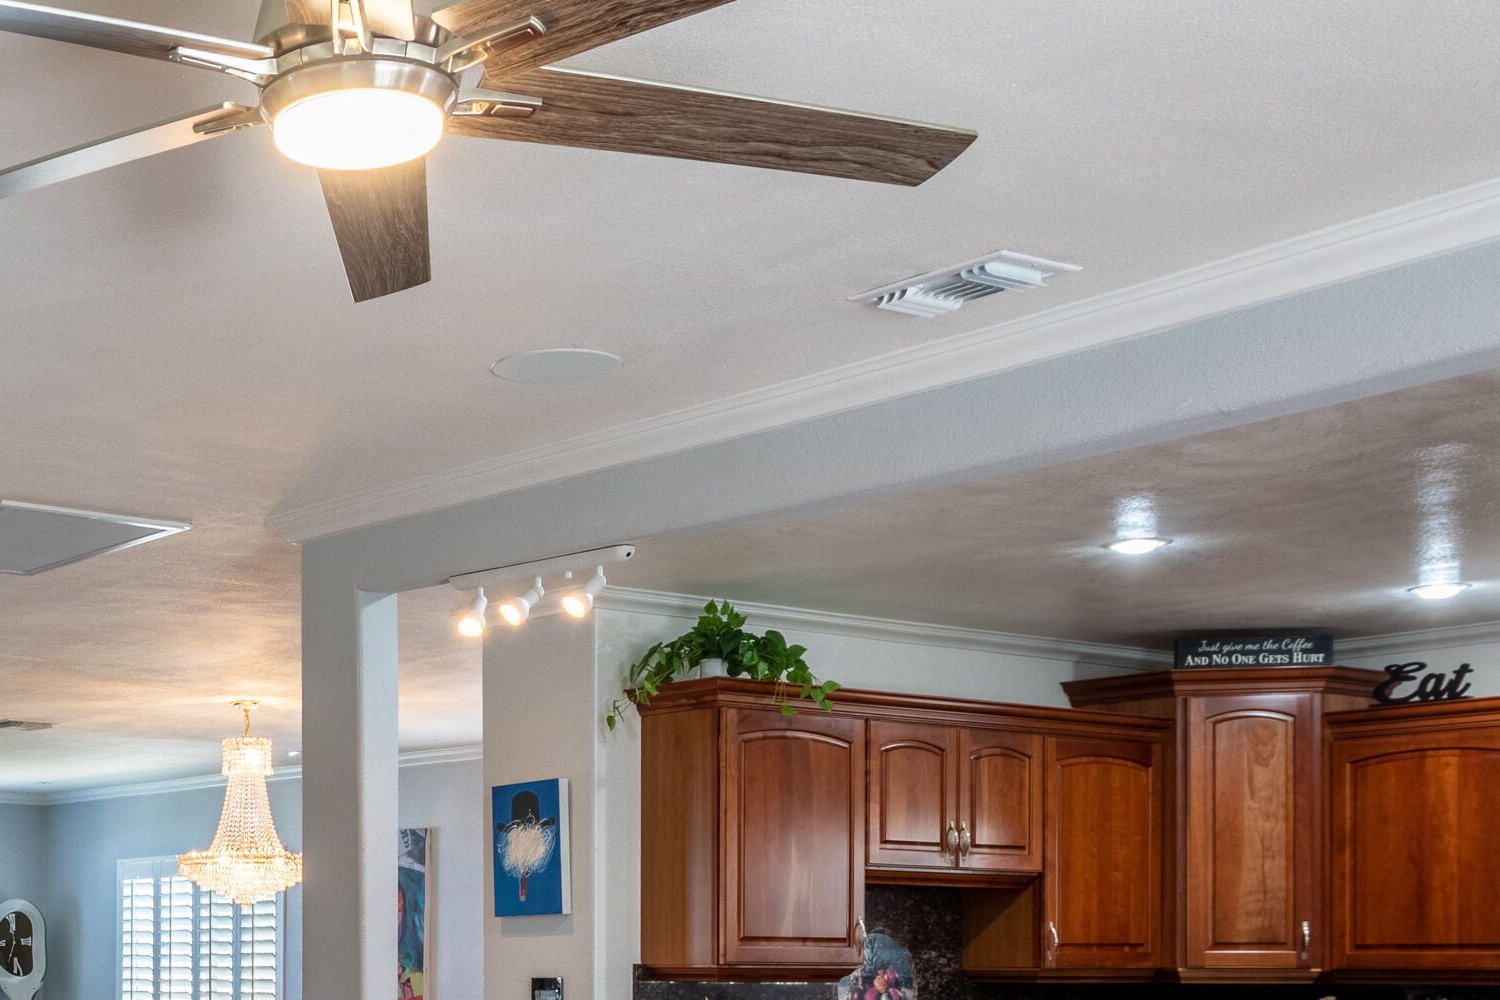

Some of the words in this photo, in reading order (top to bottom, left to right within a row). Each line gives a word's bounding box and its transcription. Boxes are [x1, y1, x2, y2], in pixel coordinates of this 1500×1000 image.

[1198, 640, 1219, 653] Just
[1221, 641, 1243, 654] give
[1244, 643, 1260, 651] me
[1261, 639, 1279, 650] the
[1280, 637, 1313, 651] Coffee
[1374, 662, 1473, 704] Eat
